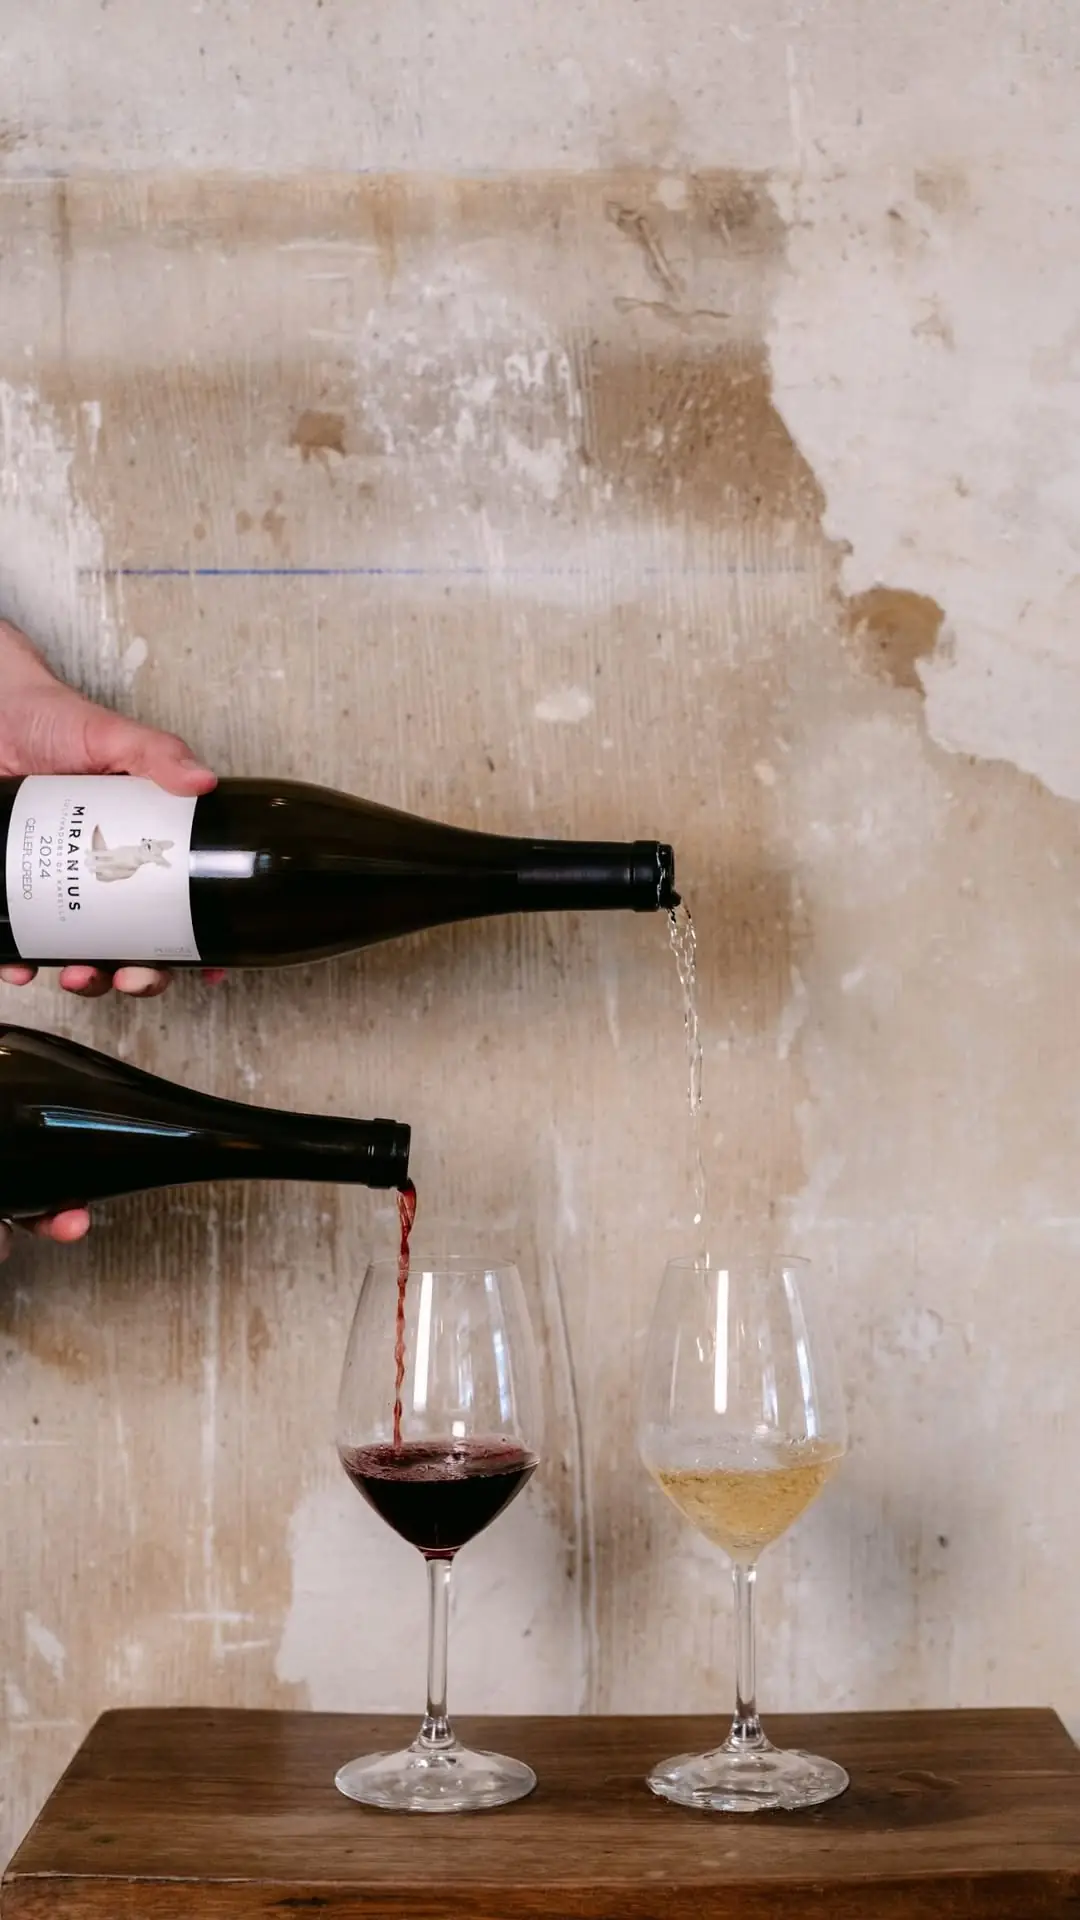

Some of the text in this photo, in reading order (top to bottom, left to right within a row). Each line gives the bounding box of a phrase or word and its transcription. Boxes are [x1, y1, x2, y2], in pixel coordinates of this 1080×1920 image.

[22, 817, 36, 900] CELLER CREDO
[39, 836, 53, 879] 2024
[67, 806, 86, 911] MIRANIUS
